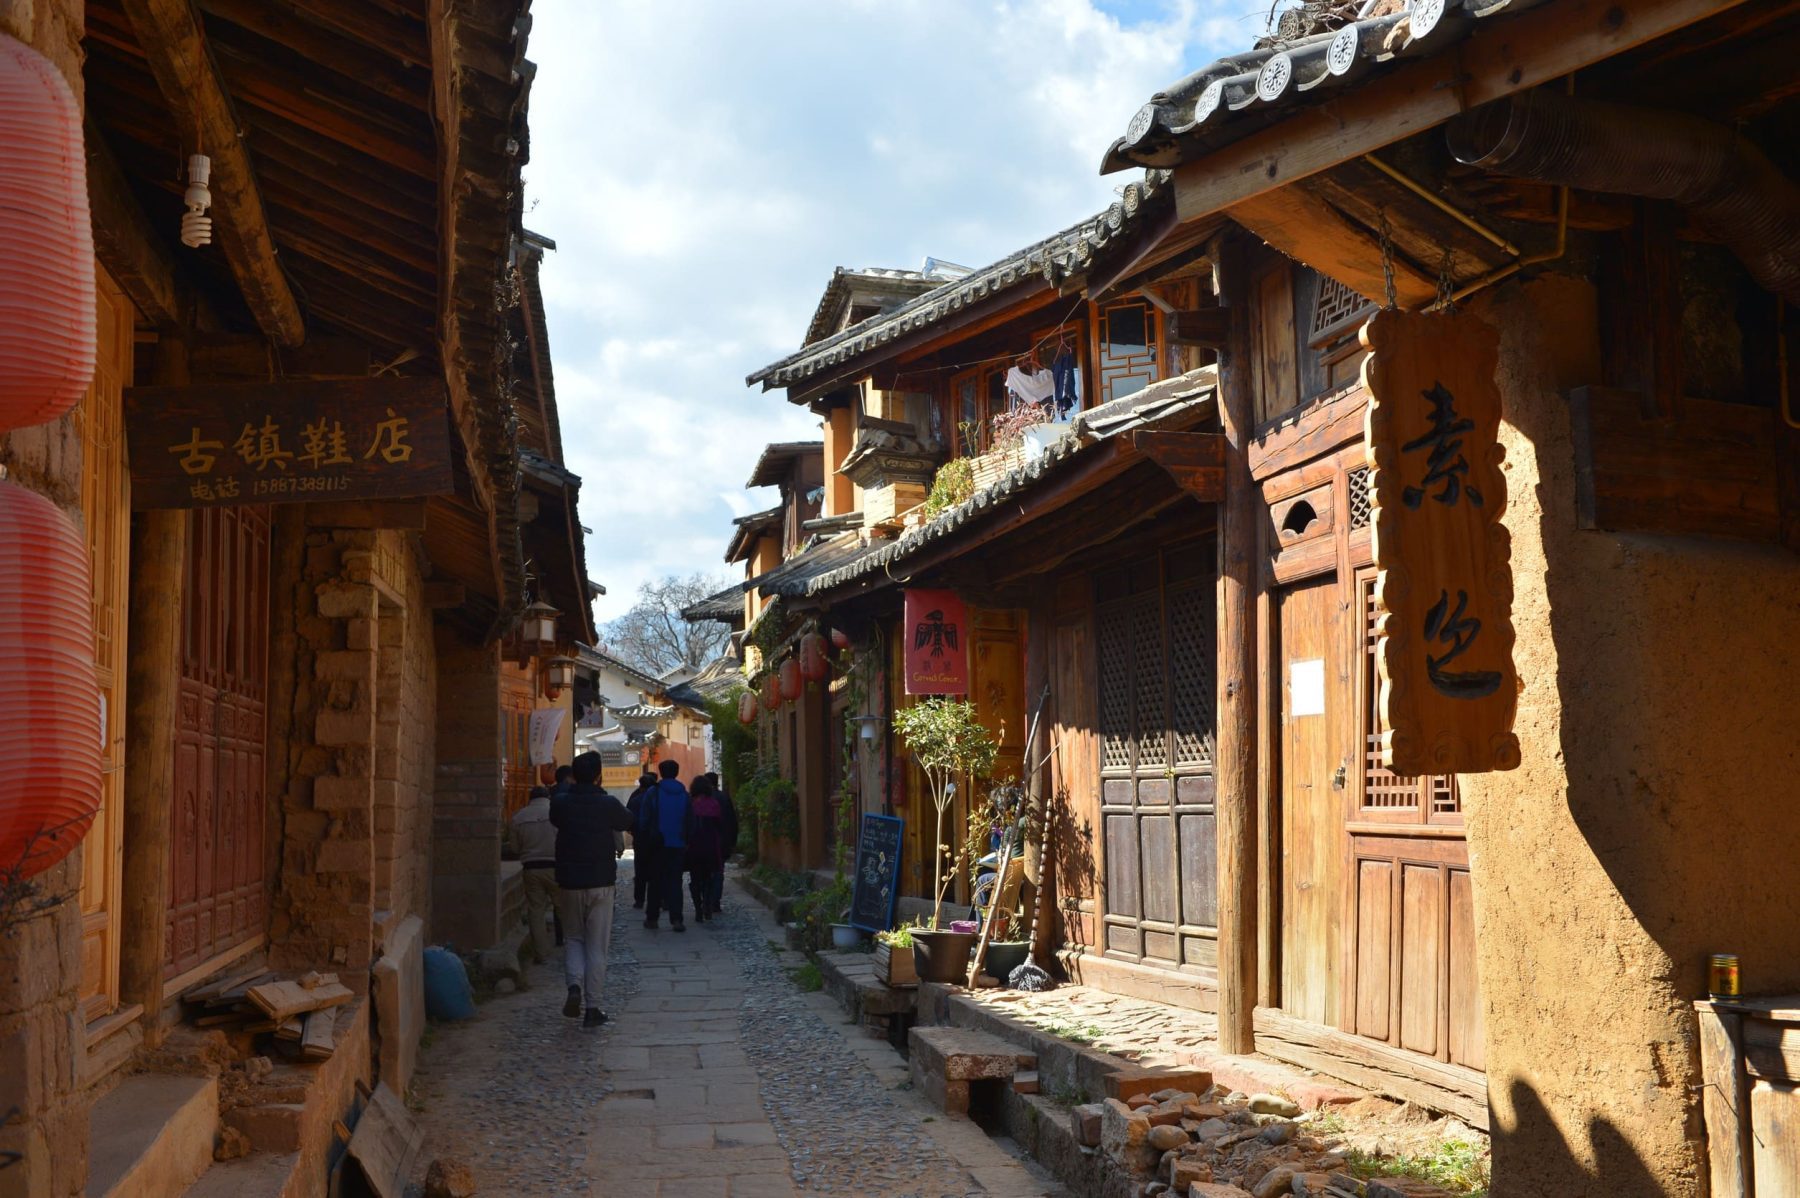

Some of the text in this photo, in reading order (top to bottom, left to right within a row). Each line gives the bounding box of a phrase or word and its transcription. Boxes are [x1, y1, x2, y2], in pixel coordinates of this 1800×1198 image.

[168, 408, 413, 475] 古镇鞋店
[190, 475, 352, 500] 电话 15887389115
